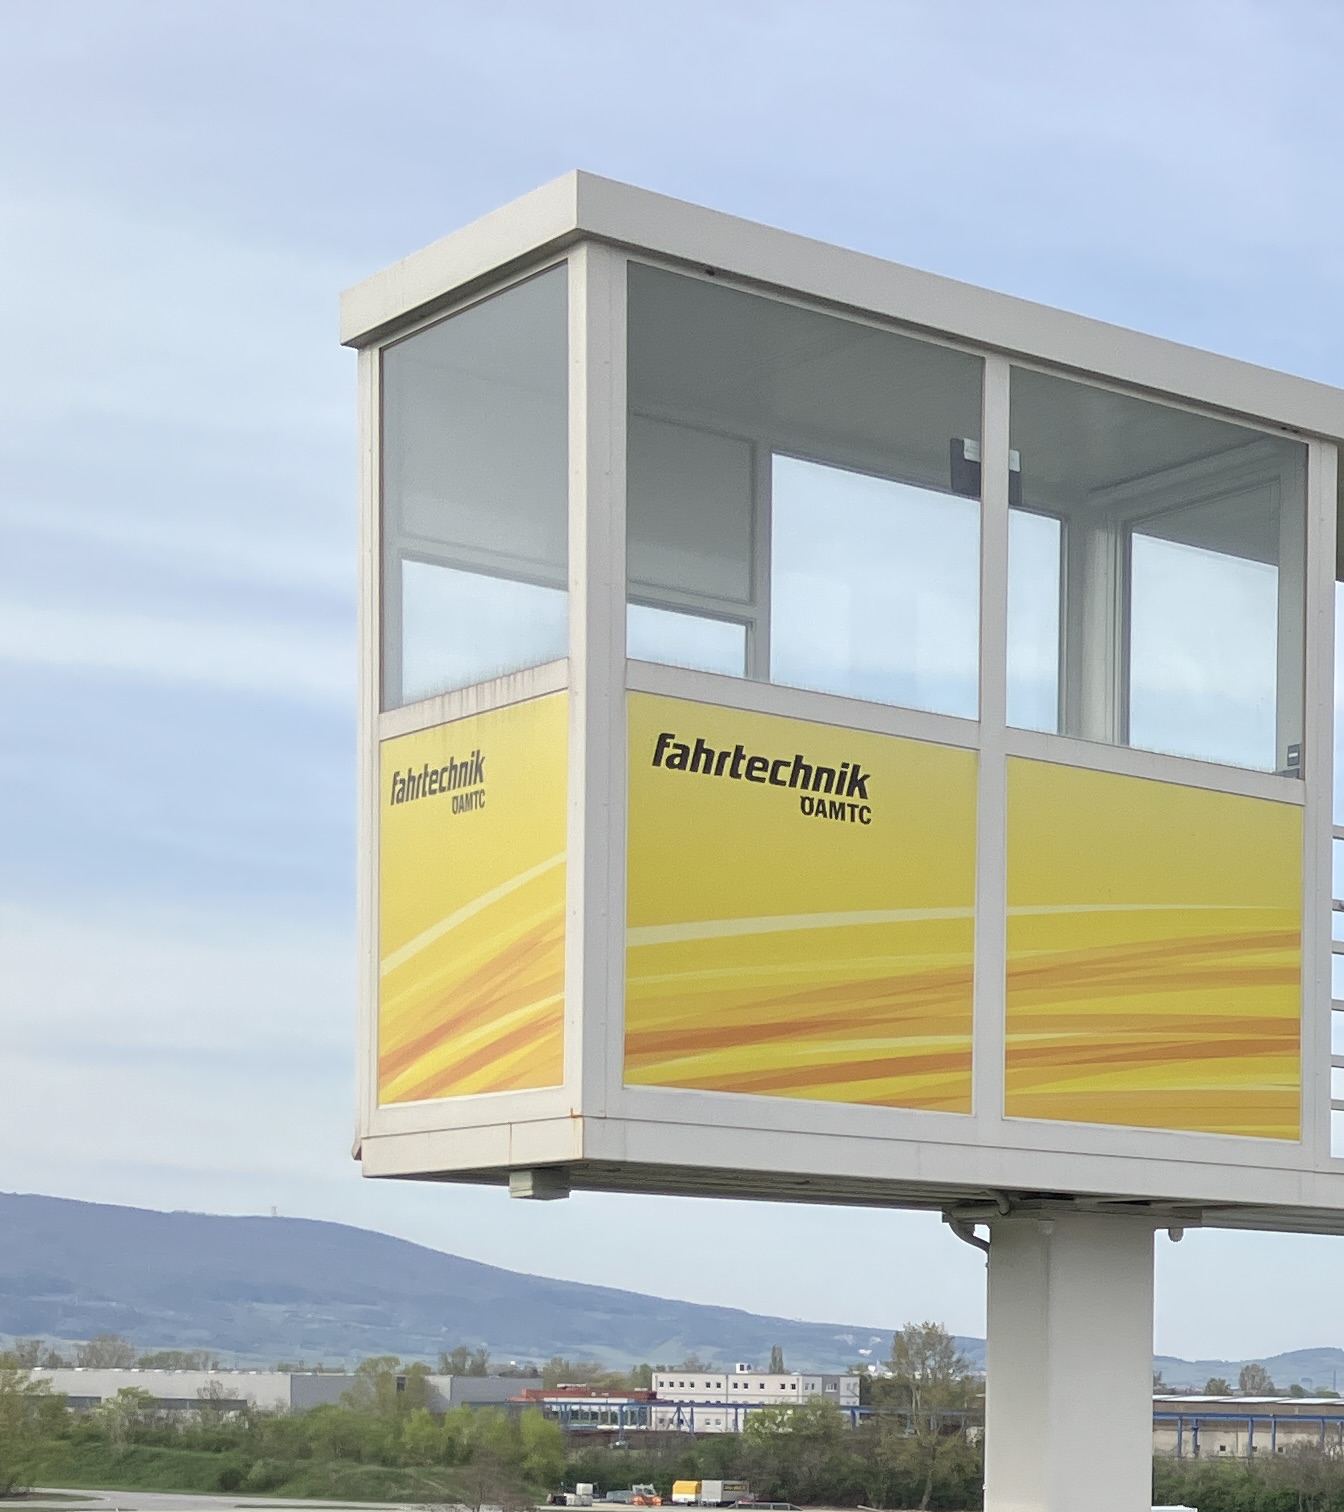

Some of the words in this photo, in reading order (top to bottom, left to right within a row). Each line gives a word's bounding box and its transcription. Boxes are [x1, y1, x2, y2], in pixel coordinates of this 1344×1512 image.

[390, 749, 486, 806] fahrtechnik
[652, 732, 871, 800] fahrtechnik
[800, 795, 872, 825] ÖAMTC
